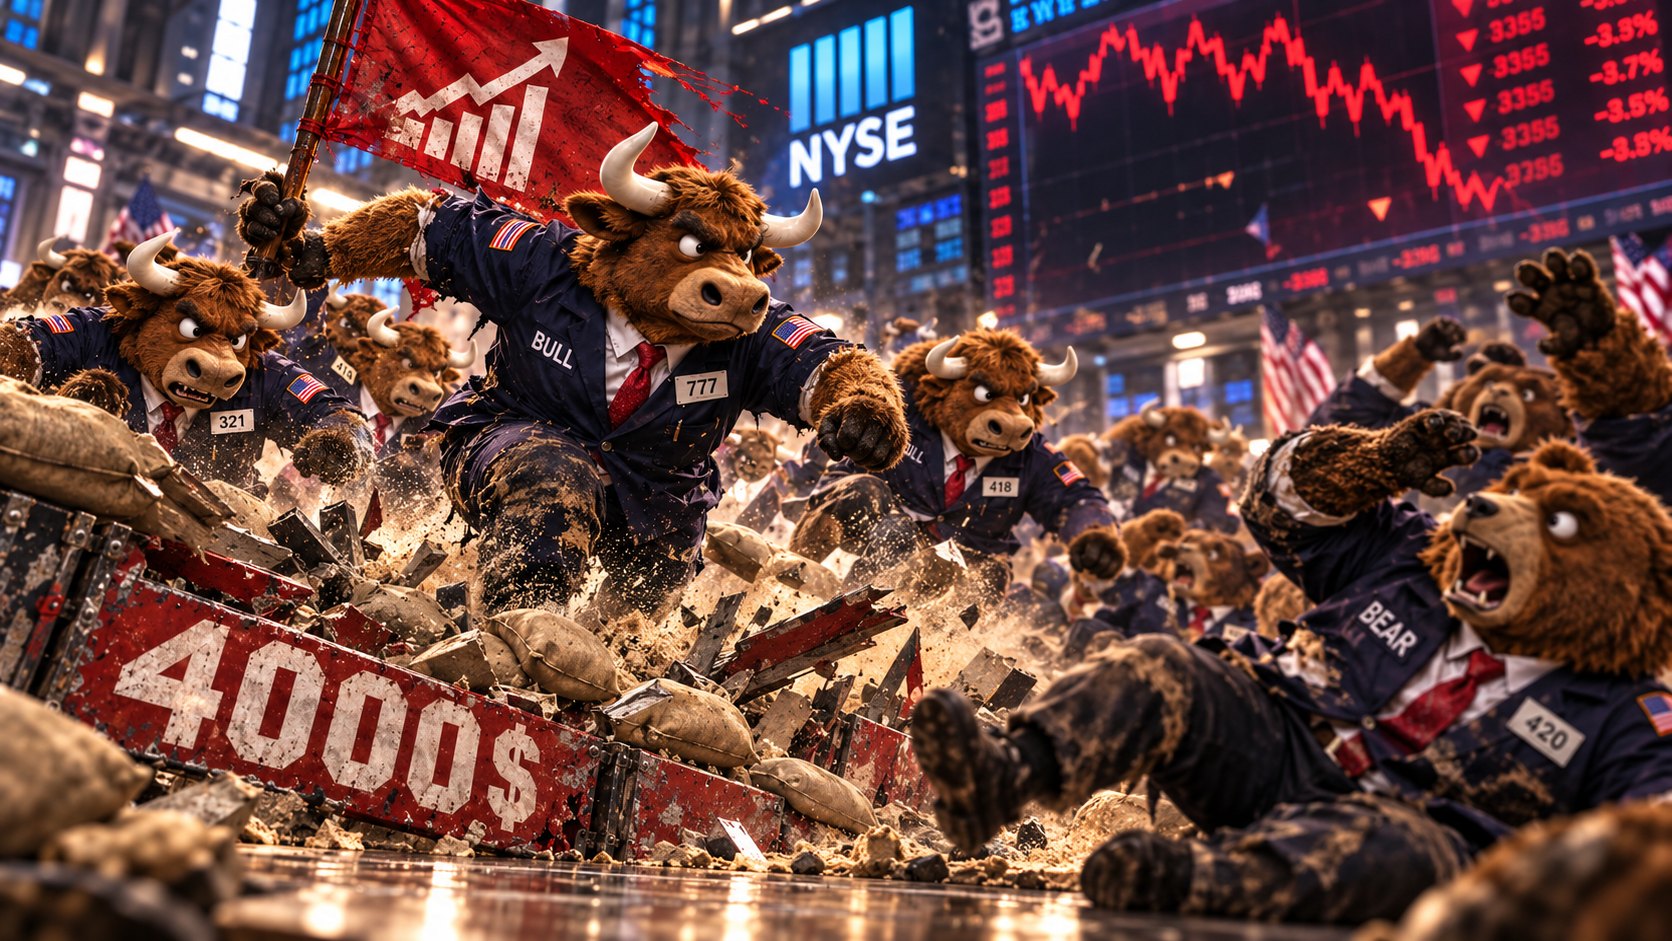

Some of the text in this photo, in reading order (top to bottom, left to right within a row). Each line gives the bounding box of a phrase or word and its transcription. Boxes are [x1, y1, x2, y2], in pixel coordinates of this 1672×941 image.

[1589, 47, 1665, 86] -3.7%
[1593, 86, 1670, 124] -3.5%
[789, 105, 917, 189] NYSE
[530, 329, 573, 370] BULL
[686, 377, 717, 397] 777
[219, 414, 245, 429] 321
[903, 442, 924, 464] ULL
[989, 481, 1012, 493] 418
[1358, 600, 1418, 658] BEAR
[113, 619, 541, 832] 4000$
[1524, 714, 1569, 752] 420
